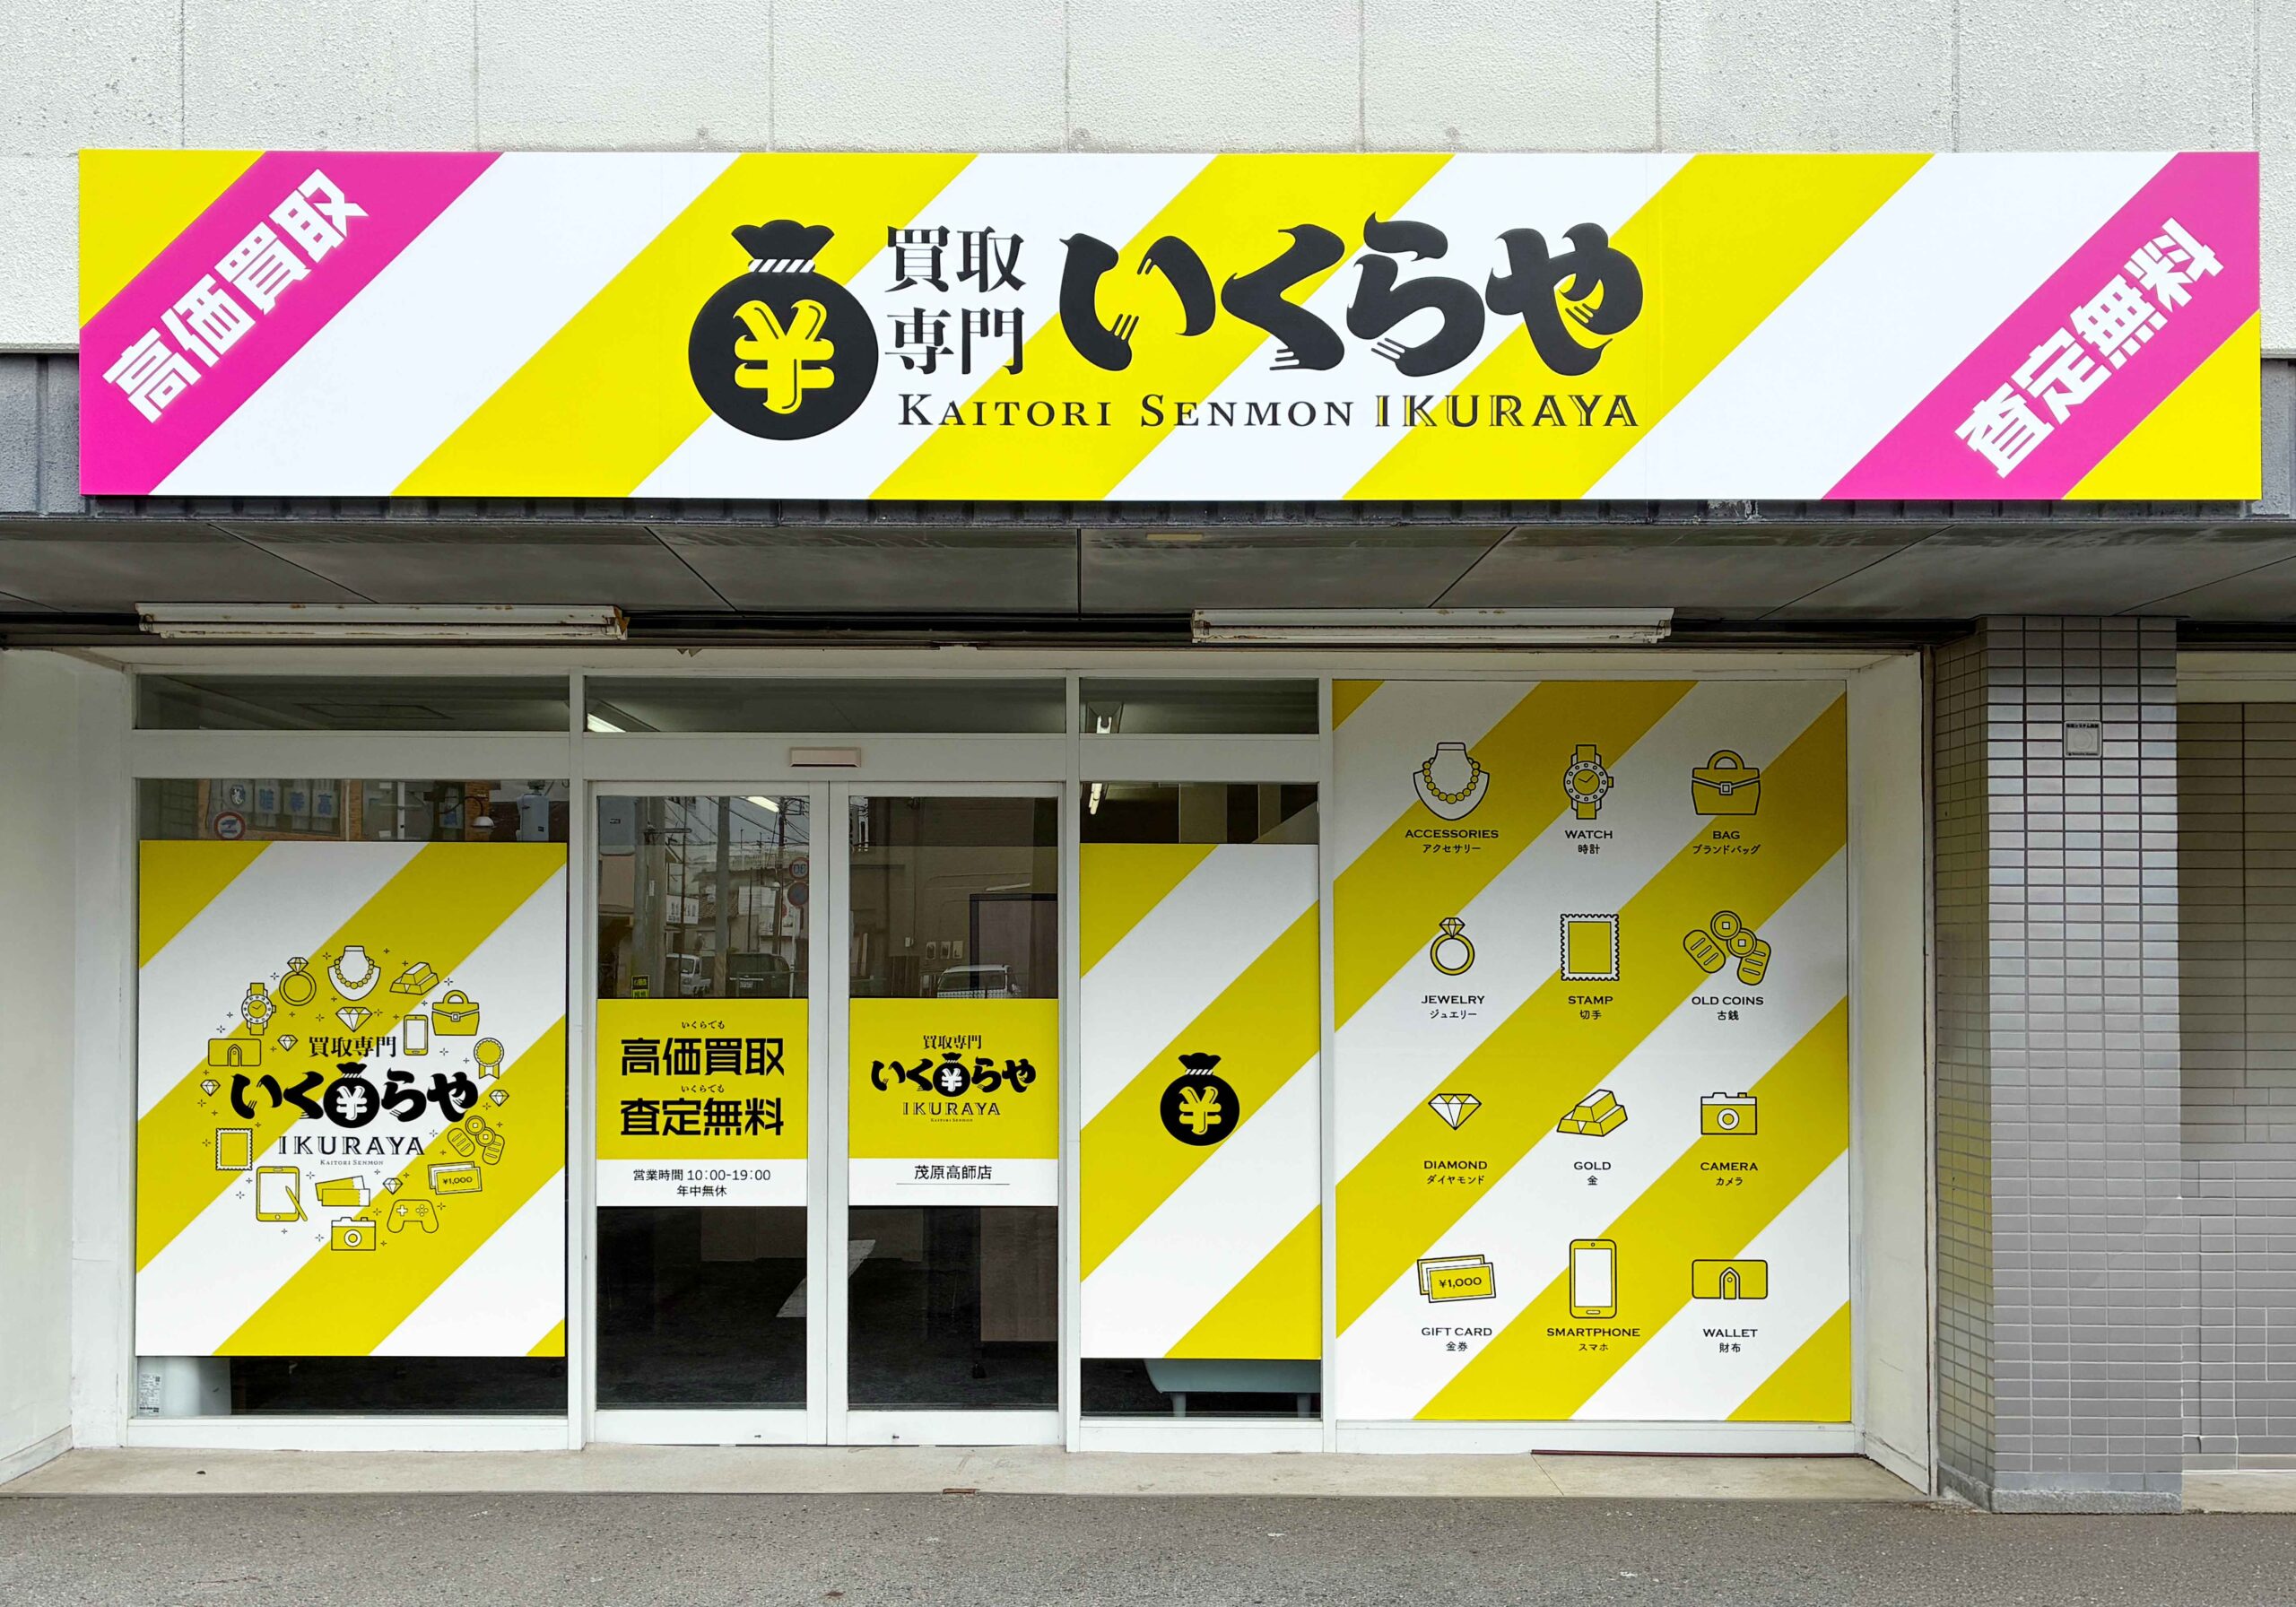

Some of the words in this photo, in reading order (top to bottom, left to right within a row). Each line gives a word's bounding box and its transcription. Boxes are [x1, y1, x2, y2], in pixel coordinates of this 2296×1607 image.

[885, 226, 1026, 292] 買取
[102, 168, 370, 424] 高価買取
[1059, 212, 1643, 377] いくらや
[885, 308, 1024, 375] 専門
[1954, 217, 2225, 480] 査定無料
[899, 395, 1110, 426] KAITORI
[1141, 395, 1353, 427] SENMON
[1377, 395, 1639, 427] IKURAYA
[1405, 830, 1499, 838] ACCESSORIES
[1565, 830, 1613, 838] WATCH
[1713, 831, 1740, 839] BAG
[1423, 844, 1481, 854] アクセサリー
[1578, 844, 1600, 854] 時計
[1693, 844, 1761, 855] ブランドバッグ
[1422, 995, 1484, 1003] JEWELRY
[1569, 996, 1613, 1004] STAMP
[1692, 996, 1718, 1004] OLD
[1723, 997, 1763, 1005] COINS
[1431, 1009, 1476, 1019] ジュエリー
[1580, 1010, 1601, 1020] 切手
[309, 1036, 396, 1057] 買取専門
[924, 1035, 981, 1049] 買取専門
[622, 1038, 784, 1076] 高価買取
[903, 1102, 1000, 1115] IKURAYA
[621, 1098, 784, 1135] 査定無料
[279, 1136, 425, 1155] IKURAYA
[1424, 1161, 1487, 1169] DIAMOND
[1574, 1162, 1611, 1170] GOLD
[1700, 1162, 1758, 1170] CAMERA
[633, 1169, 683, 1181] 営業時間
[915, 1165, 992, 1179] 茂原高師店
[1428, 1175, 1484, 1185] ダイヤモンド
[1587, 1176, 1597, 1185] 金
[1716, 1177, 1743, 1186] カメラ
[677, 1185, 726, 1196] 年中無休
[1439, 1277, 1482, 1288] ¥1,000
[1422, 1327, 1451, 1335] GIFT
[1455, 1328, 1492, 1336] CARD
[1547, 1328, 1640, 1336] SMARTPHONE
[1703, 1329, 1758, 1337] WALLET
[1446, 1342, 1467, 1351] 金券
[1578, 1343, 1608, 1351] スマホ
[1719, 1342, 1741, 1352] 財布
